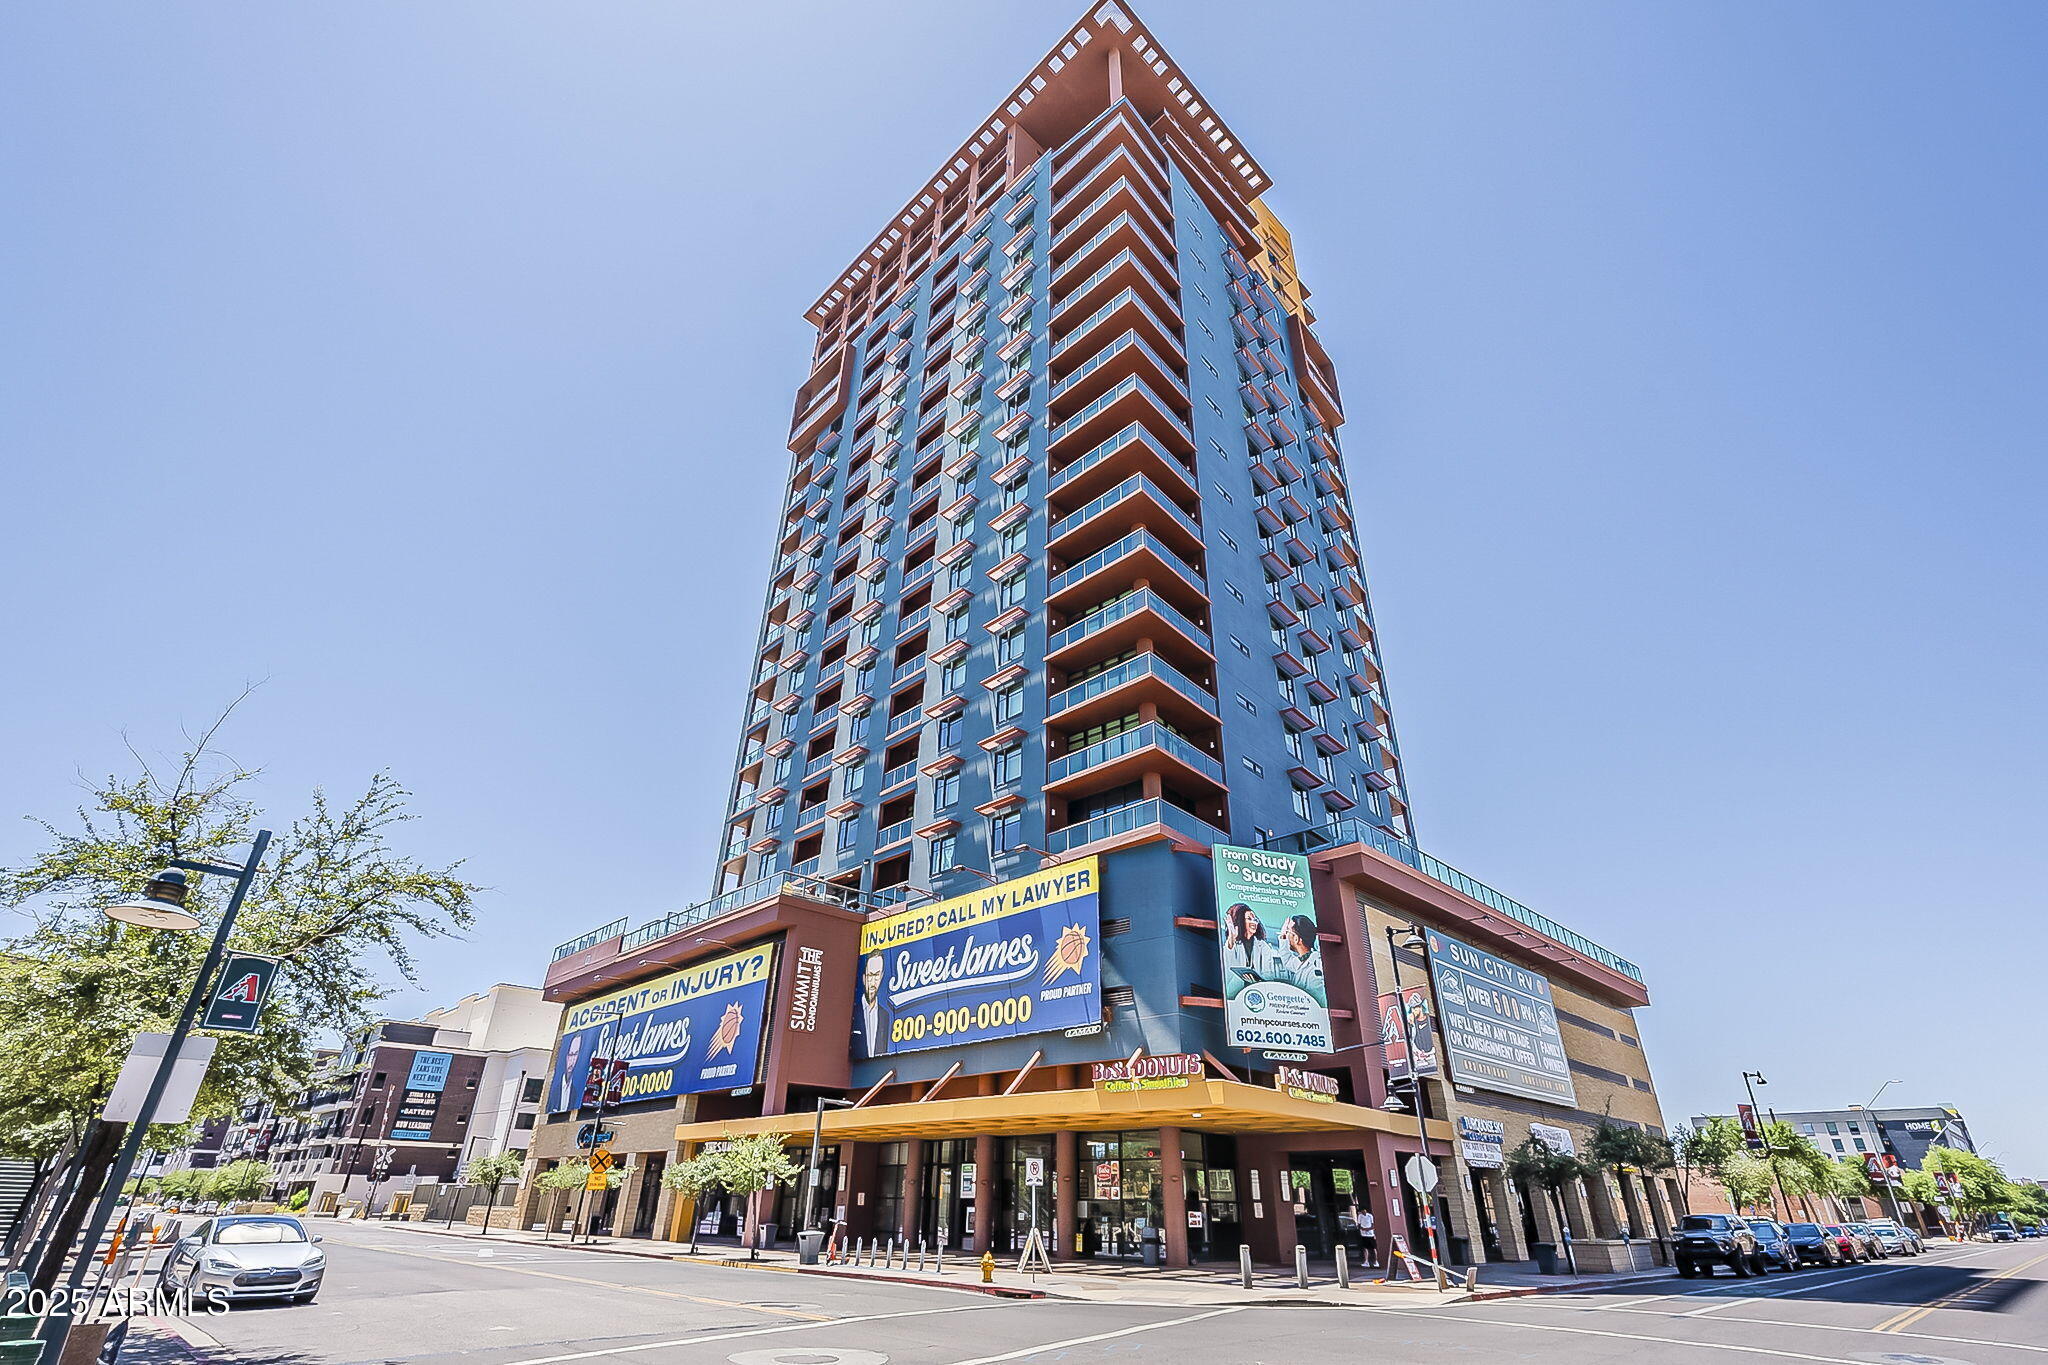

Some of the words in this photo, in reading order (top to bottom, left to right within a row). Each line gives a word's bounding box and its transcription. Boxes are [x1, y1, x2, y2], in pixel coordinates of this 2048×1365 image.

[1222, 848, 1249, 861] From
[1252, 852, 1297, 875] Study
[1226, 861, 1240, 873] to
[1242, 867, 1304, 888] Success
[1226, 882, 1279, 896] Comprehensive
[1238, 893, 1281, 905] Certification
[1281, 898, 1298, 907] Prep
[865, 913, 935, 949] INJURED?
[937, 907, 977, 929] CALL
[981, 894, 1007, 917] MY
[1012, 869, 1091, 909] LAWYER
[1449, 943, 1481, 970] SUN
[1483, 958, 1514, 983] CITY
[1516, 972, 1534, 992] RV
[568, 988, 651, 1030] ACCIDENT
[651, 988, 668, 1004] OR
[670, 954, 764, 1000] INJURY?
[790, 961, 812, 1030] SUMMIT
[806, 965, 822, 1032] CONDOMINIUMS
[1040, 988, 1063, 1002] PROUD
[1063, 982, 1093, 999] PARTNER
[1266, 991, 1311, 1004] Georgette's
[1465, 984, 1491, 1009] OVER
[1491, 990, 1520, 1022] 500
[891, 994, 1032, 1044] 800-900-0000
[1240, 1016, 1320, 1030] pmhnpcourses.com
[1448, 1011, 1473, 1033] WE'LL
[1472, 1019, 1492, 1039] BEAT
[1493, 1026, 1509, 1042] ANY
[1507, 1031, 1531, 1050] TRADE
[1236, 1029, 1326, 1048] 602.600.7485
[1449, 1029, 1463, 1047] OR
[1462, 1033, 1514, 1061] CONSIGNMENT
[1513, 1049, 1537, 1066] OFFER
[1133, 1053, 1203, 1079] DONUTS
[1104, 1080, 1132, 1093] Coffee
[1140, 1076, 1188, 1090] Smoothies
[404, 1107, 436, 1116] BATTERY
